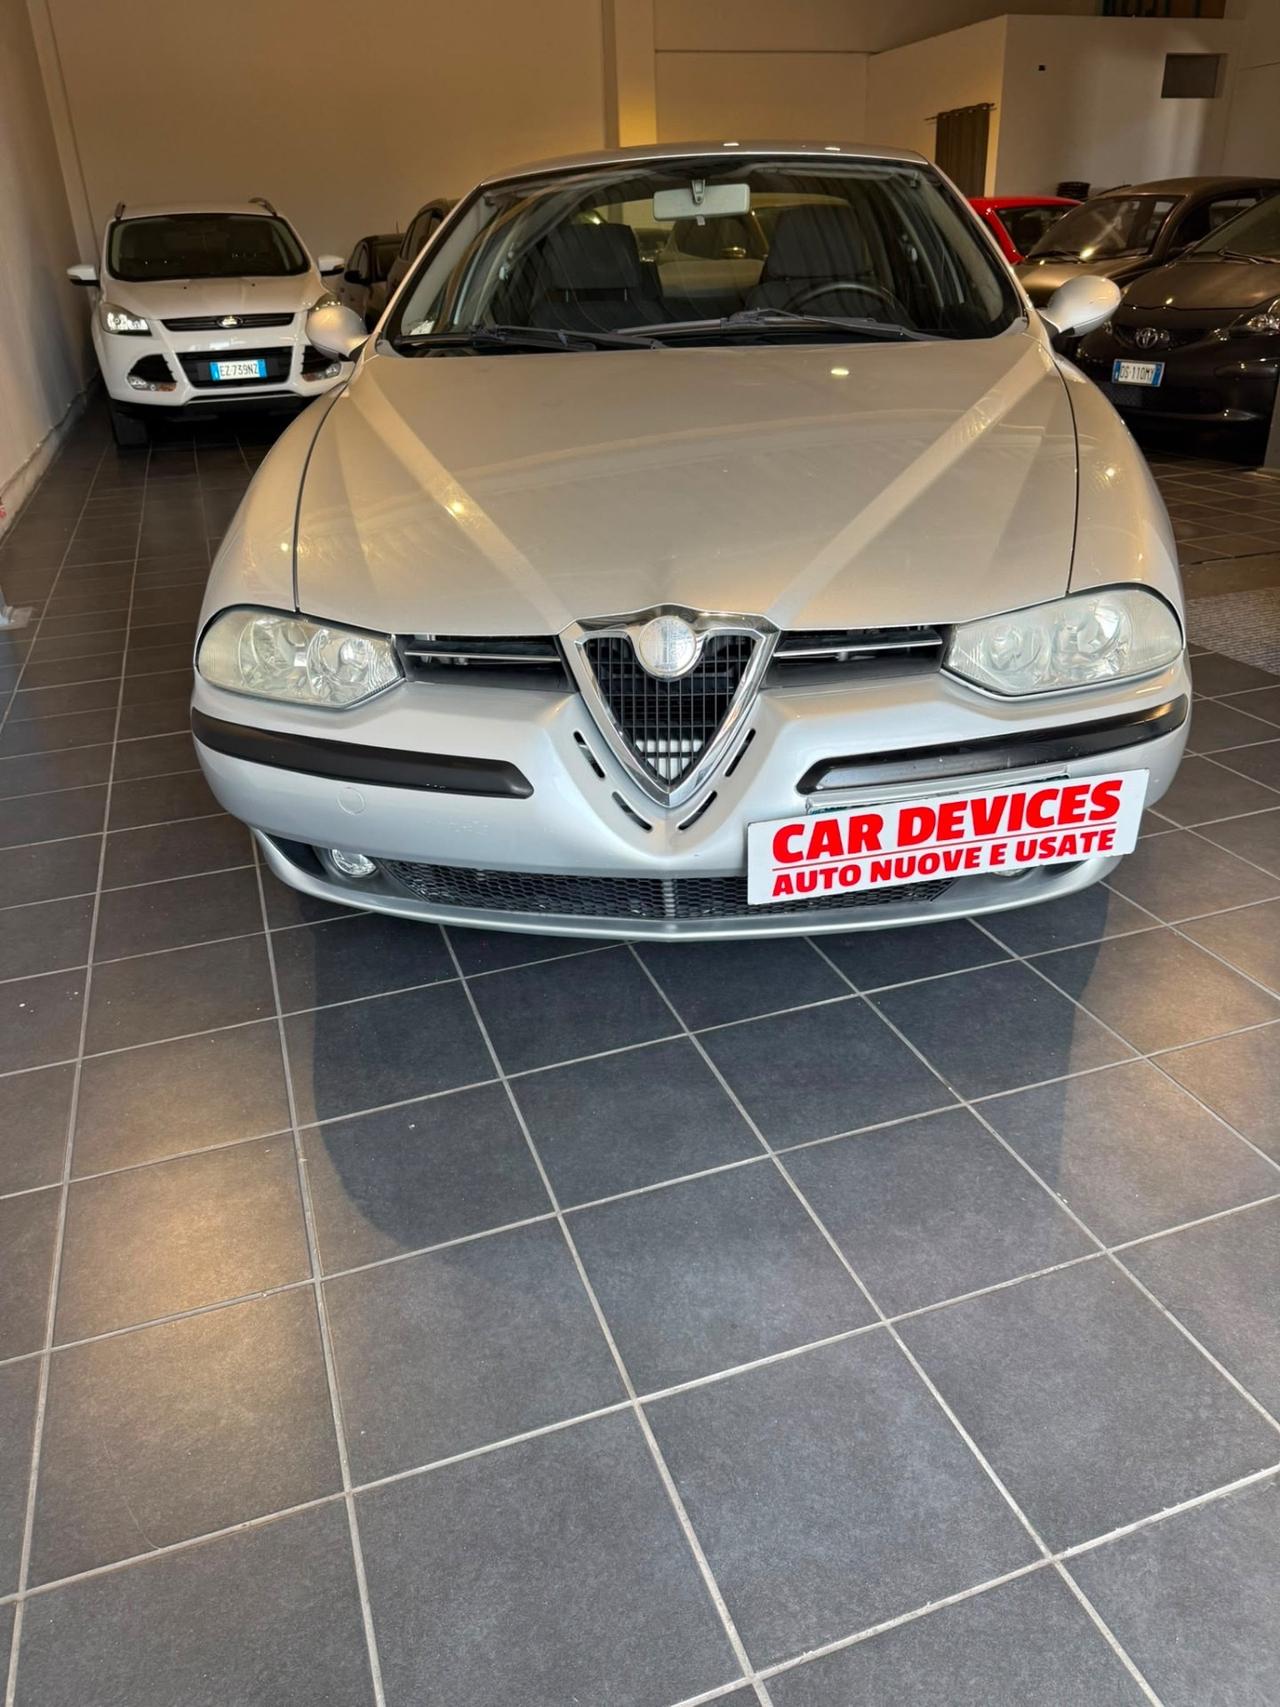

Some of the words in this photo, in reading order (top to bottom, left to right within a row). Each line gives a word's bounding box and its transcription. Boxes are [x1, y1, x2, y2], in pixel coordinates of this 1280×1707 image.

[772, 814, 884, 864] CAR
[897, 780, 1122, 847] DEVICES
[773, 861, 861, 896] AUTO
[870, 849, 981, 882] NUOVE
[989, 844, 1007, 865] E
[1015, 829, 1115, 862] USATE
